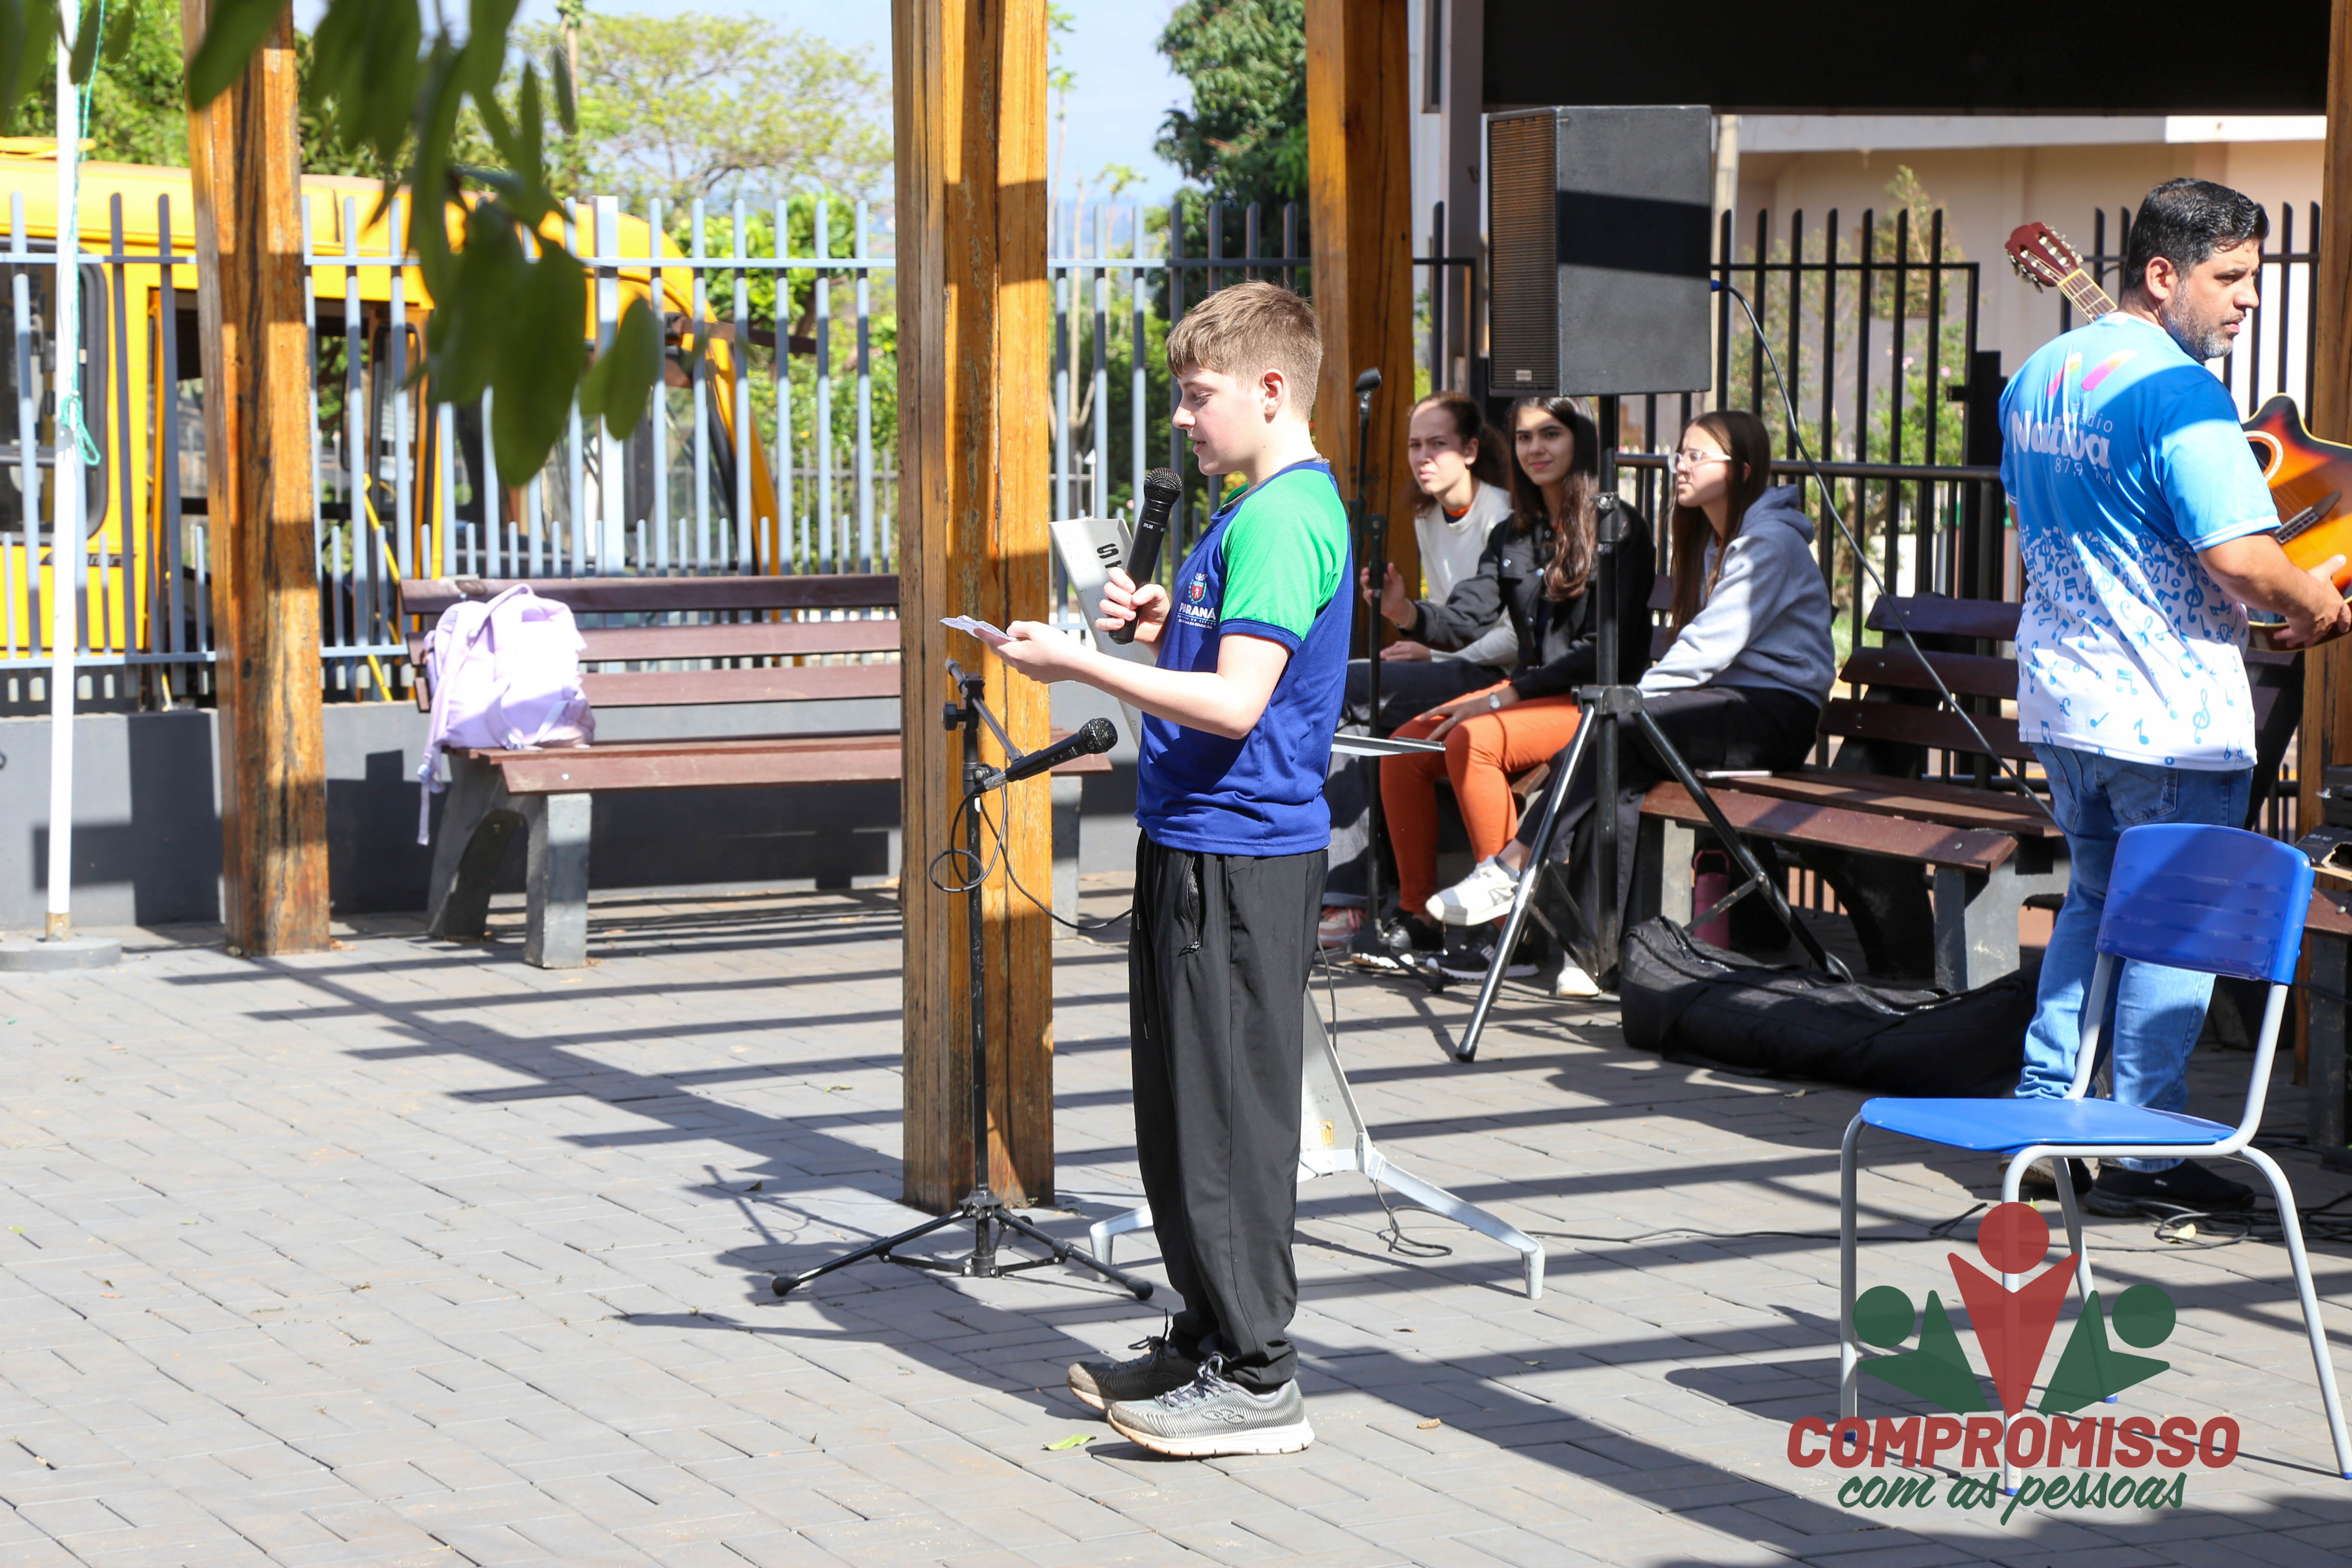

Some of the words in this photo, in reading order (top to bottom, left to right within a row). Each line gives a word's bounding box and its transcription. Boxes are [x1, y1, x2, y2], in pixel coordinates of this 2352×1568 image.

[2012, 410, 2110, 469] Nativa
[2055, 457, 2084, 476] 87,9
[1179, 602, 1216, 620] PARANÁ
